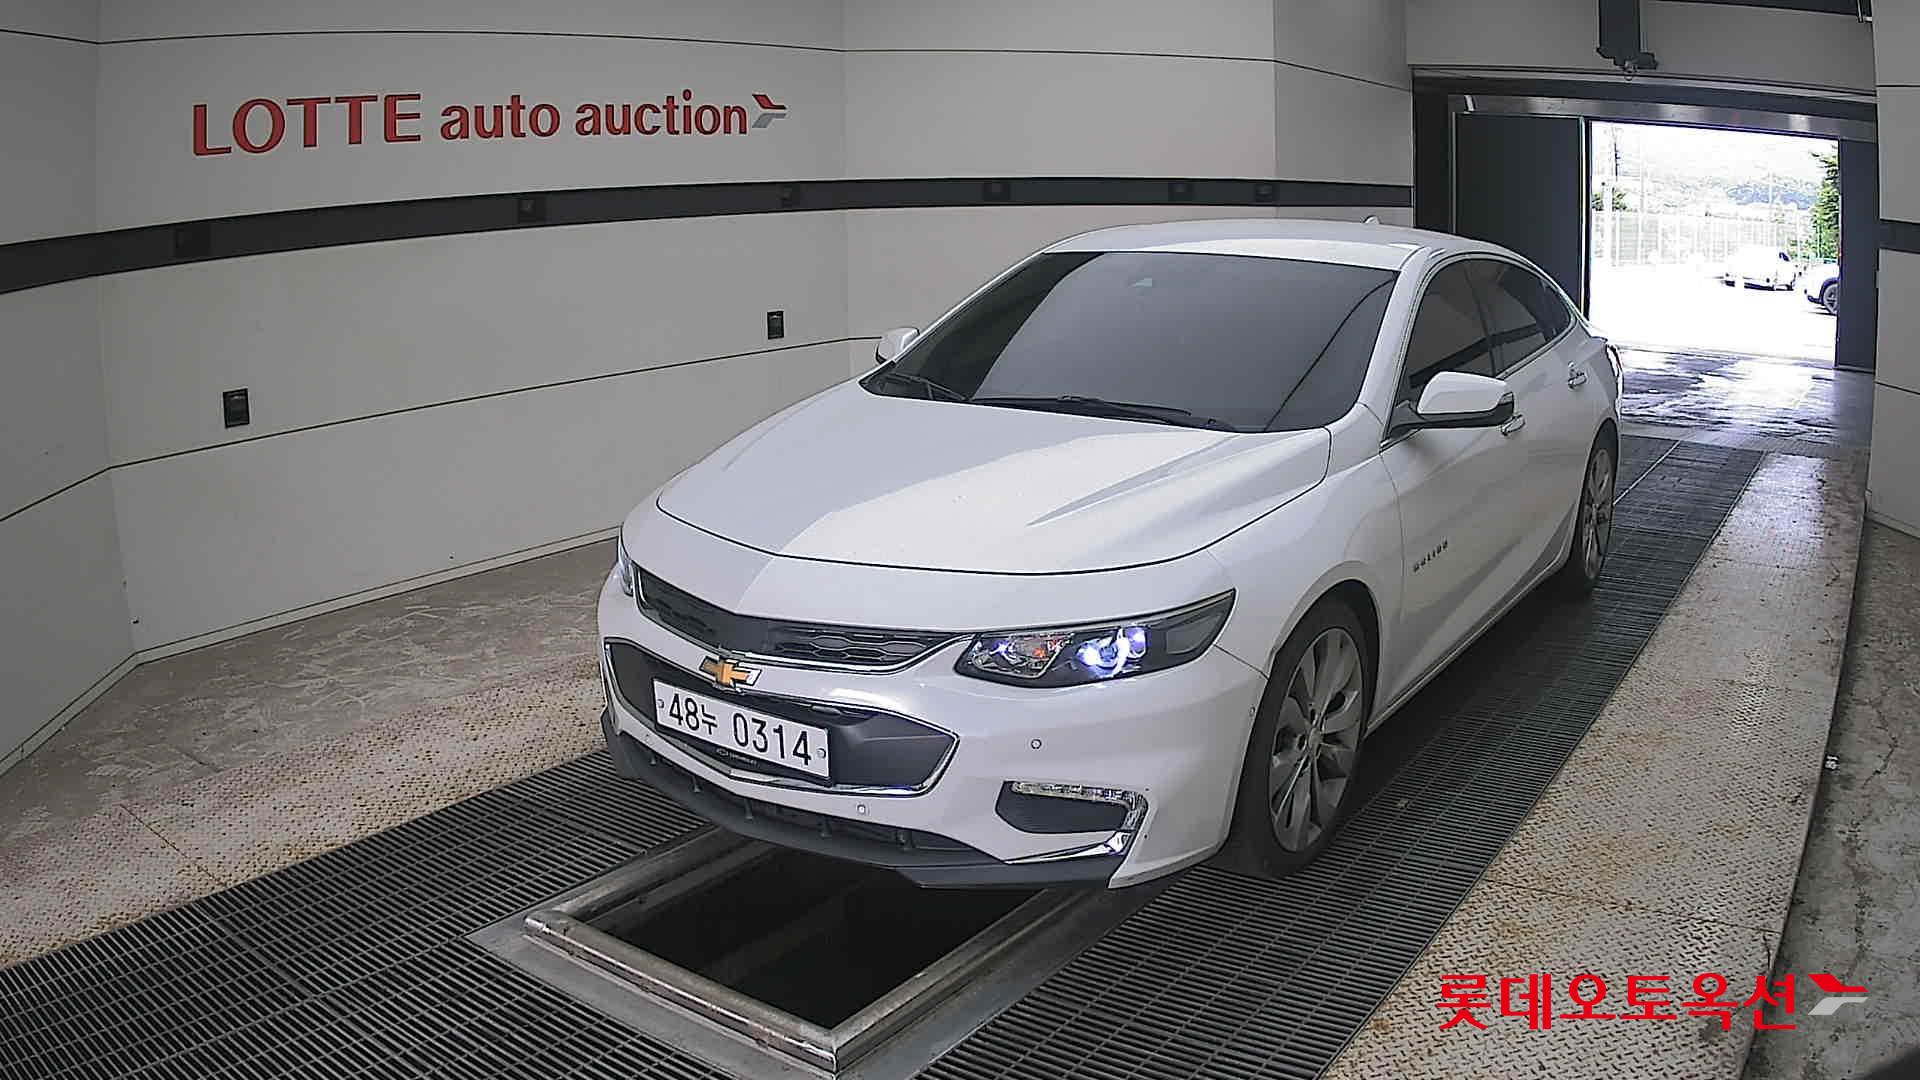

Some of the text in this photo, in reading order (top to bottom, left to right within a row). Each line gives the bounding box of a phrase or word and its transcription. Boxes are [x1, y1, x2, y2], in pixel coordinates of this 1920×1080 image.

[193, 89, 748, 156] LOTTE auto auction
[669, 693, 812, 766] 48누 0314
